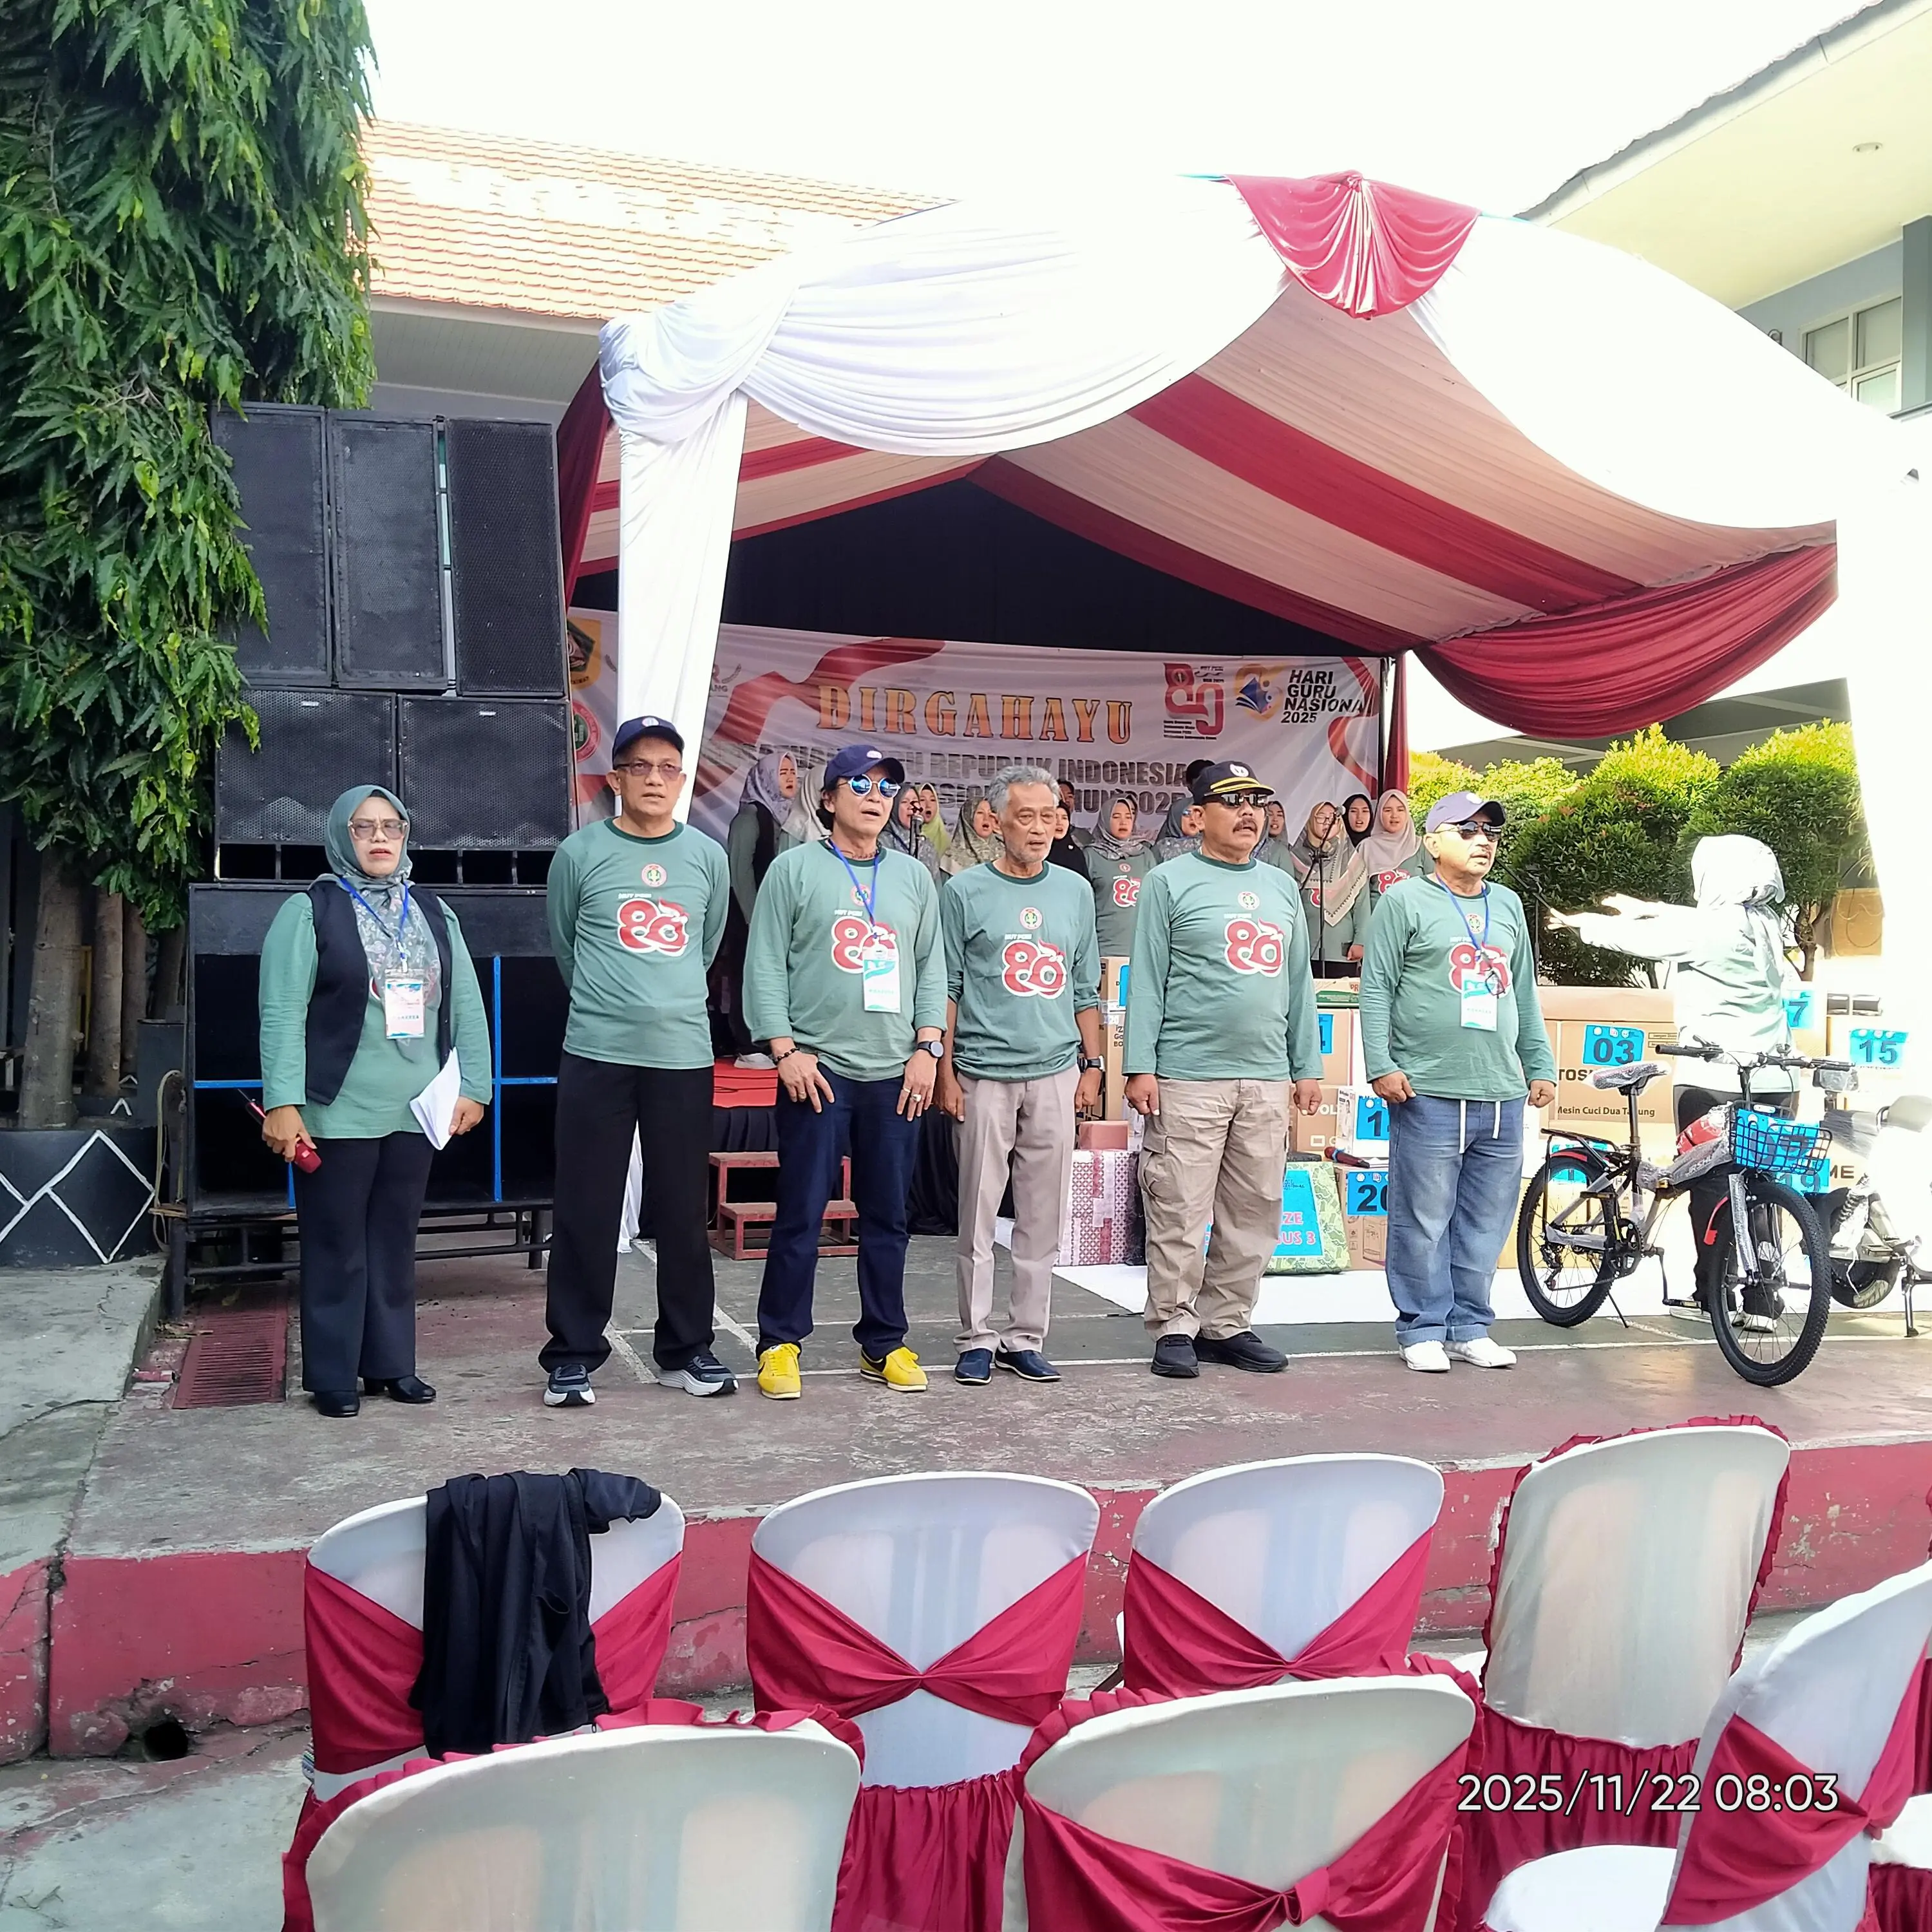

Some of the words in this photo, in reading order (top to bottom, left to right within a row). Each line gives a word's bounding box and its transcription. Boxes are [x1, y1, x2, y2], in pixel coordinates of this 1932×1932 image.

[1289, 670, 1333, 685] HARI
[1287, 685, 1336, 699] GURU
[1283, 697, 1365, 714] NASIONA
[816, 684, 1133, 744] DIRGAHAYU
[1280, 711, 1317, 724] 2025
[1058, 758, 1188, 787] INDONESIA
[1593, 1037, 1635, 1065] 03
[1859, 1039, 1899, 1065] 15
[1558, 1068, 1593, 1082] TOS
[1582, 1106, 1602, 1115] Cuci
[1603, 1107, 1621, 1115] Dua
[1622, 1107, 1655, 1118] Tung
[1307, 1232, 1316, 1245] 3
